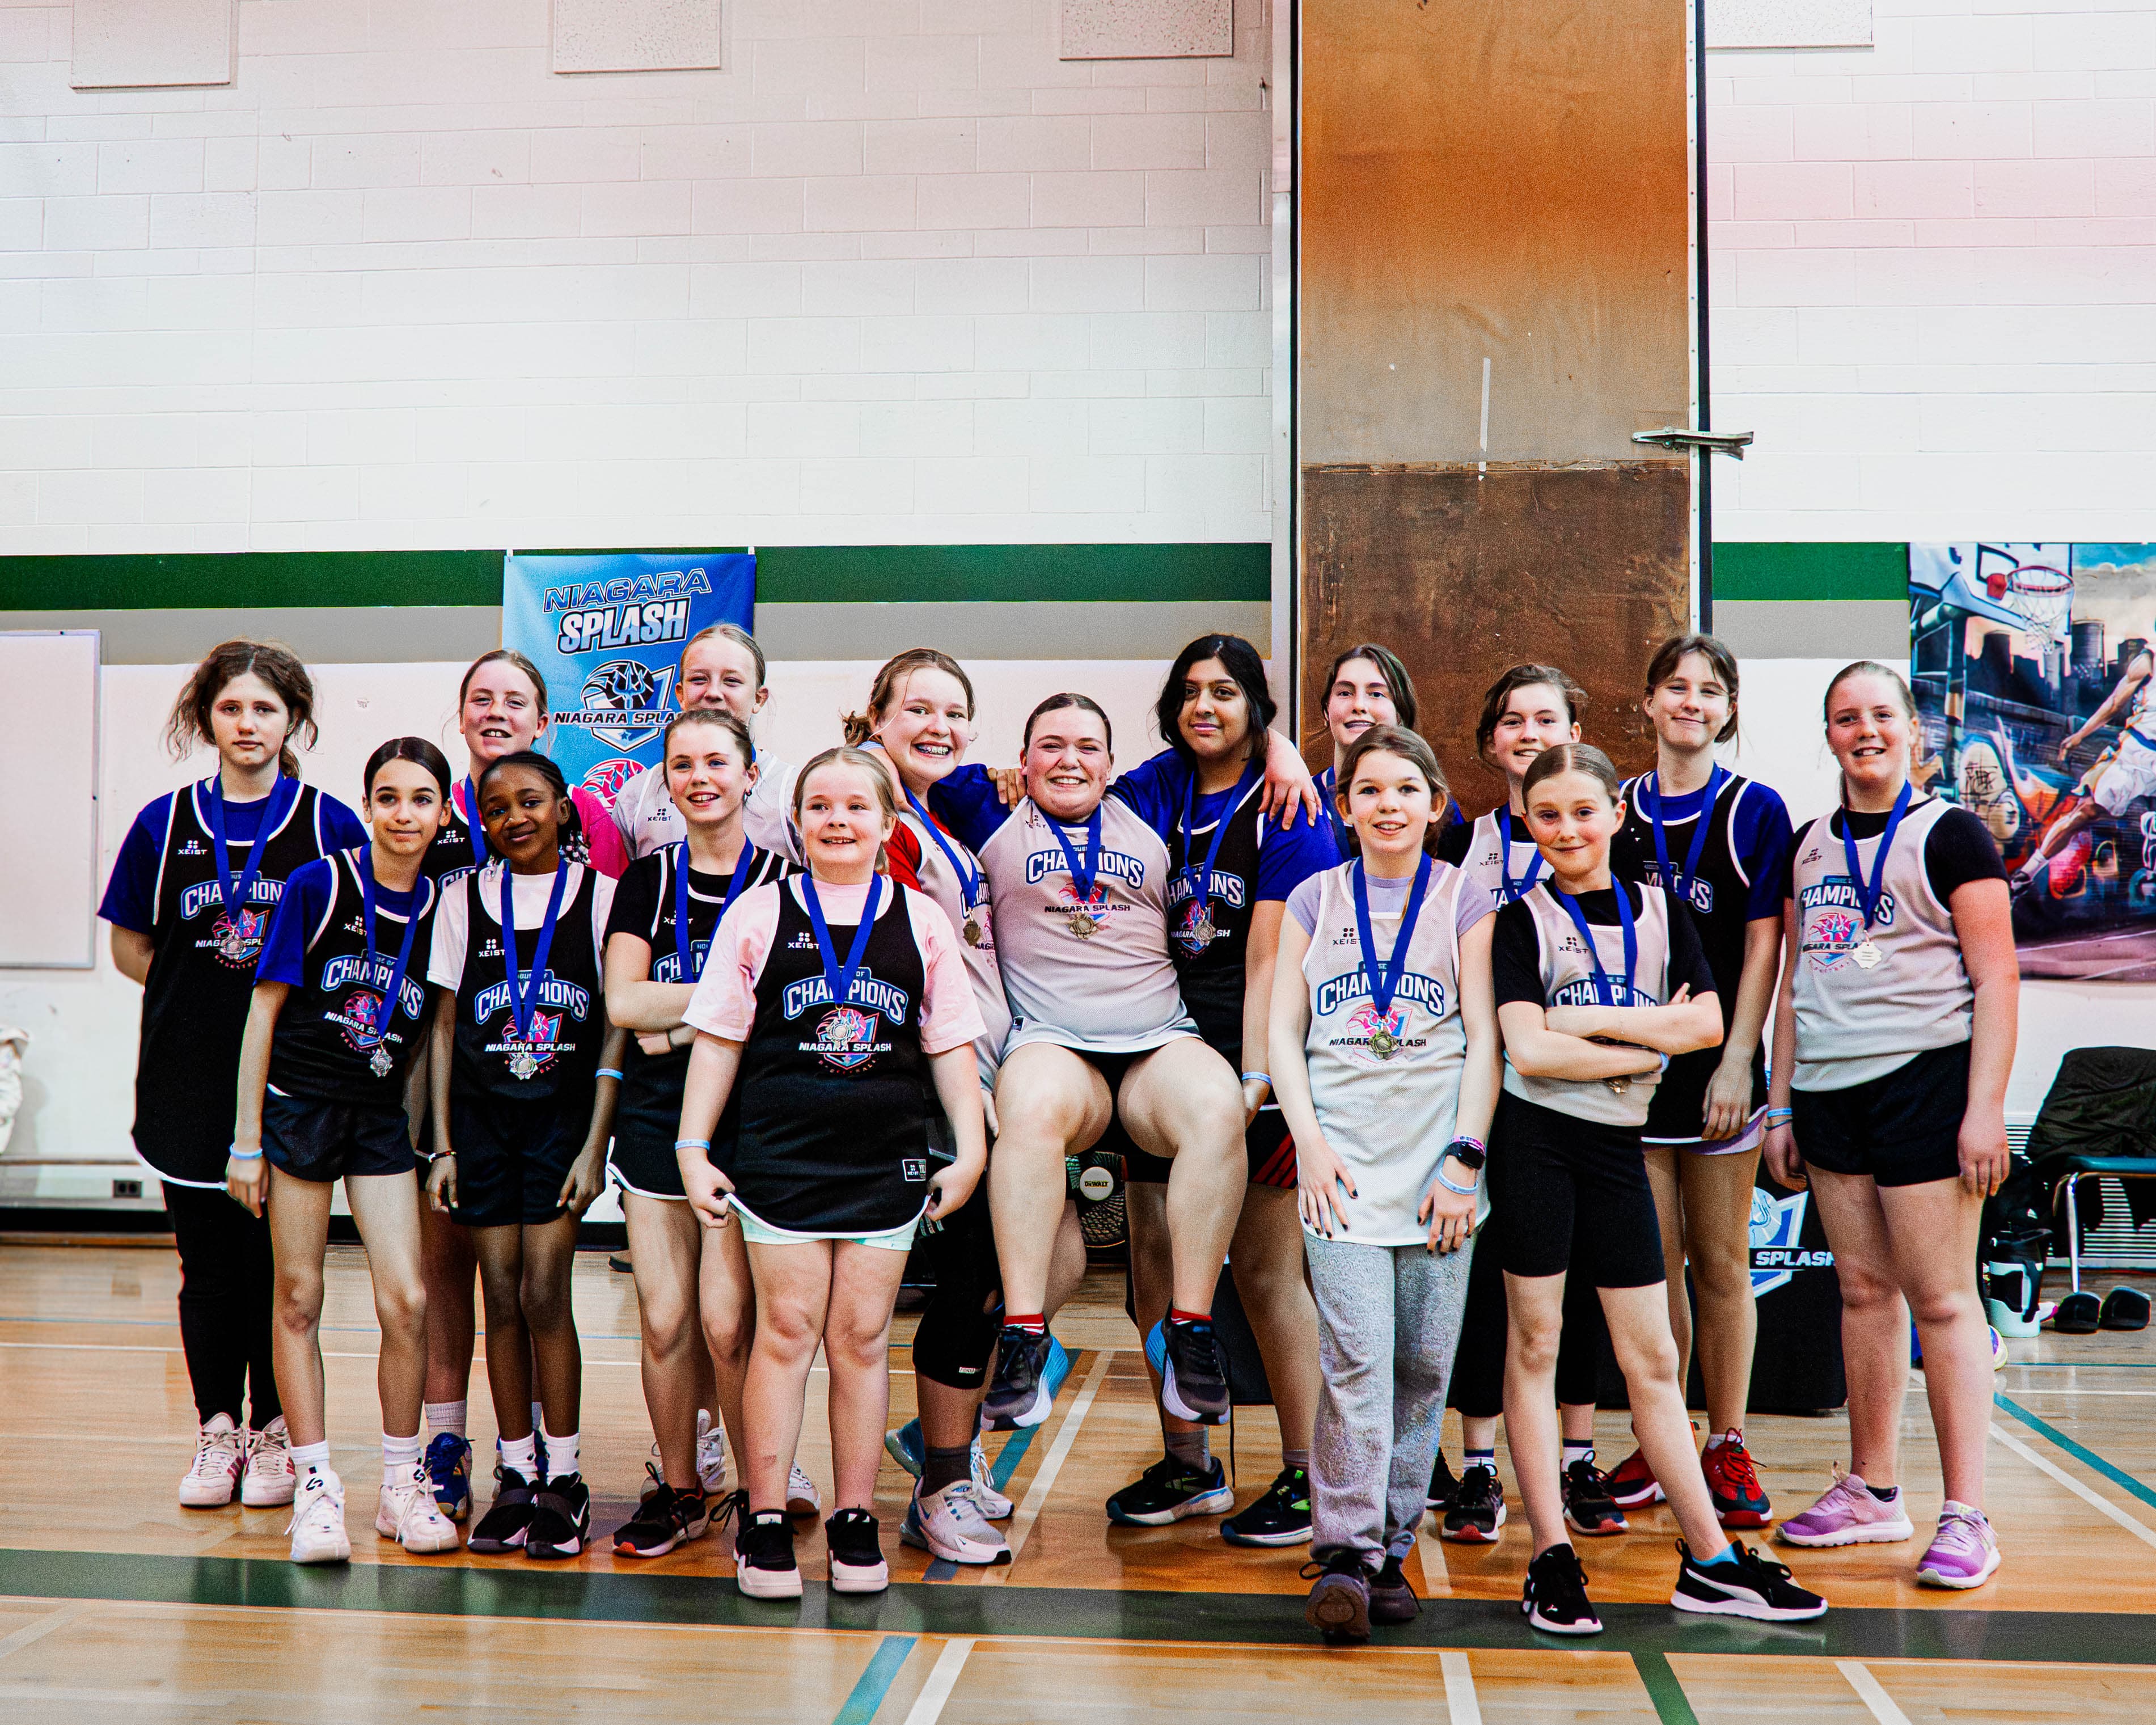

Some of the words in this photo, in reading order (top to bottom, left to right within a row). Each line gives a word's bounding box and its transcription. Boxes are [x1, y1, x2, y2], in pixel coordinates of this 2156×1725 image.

[543, 568, 712, 612] NIAGARA
[557, 597, 691, 655] SPLASH
[554, 712, 628, 724] NIAGARA
[633, 712, 676, 724] SPLA
[1802, 885, 1894, 924] HAMPIS
[663, 916, 694, 925] XET
[195, 938, 221, 948] NIAG
[479, 949, 505, 958] XEIST
[325, 959, 422, 1016] CHAMPINS
[787, 979, 906, 1021] CHAPIONS
[324, 1012, 365, 1031] NIAGARA
[535, 1043, 576, 1052] SPLASH
[852, 1042, 891, 1052] SPLASH
[1329, 1038, 1370, 1047] NIAGAR
